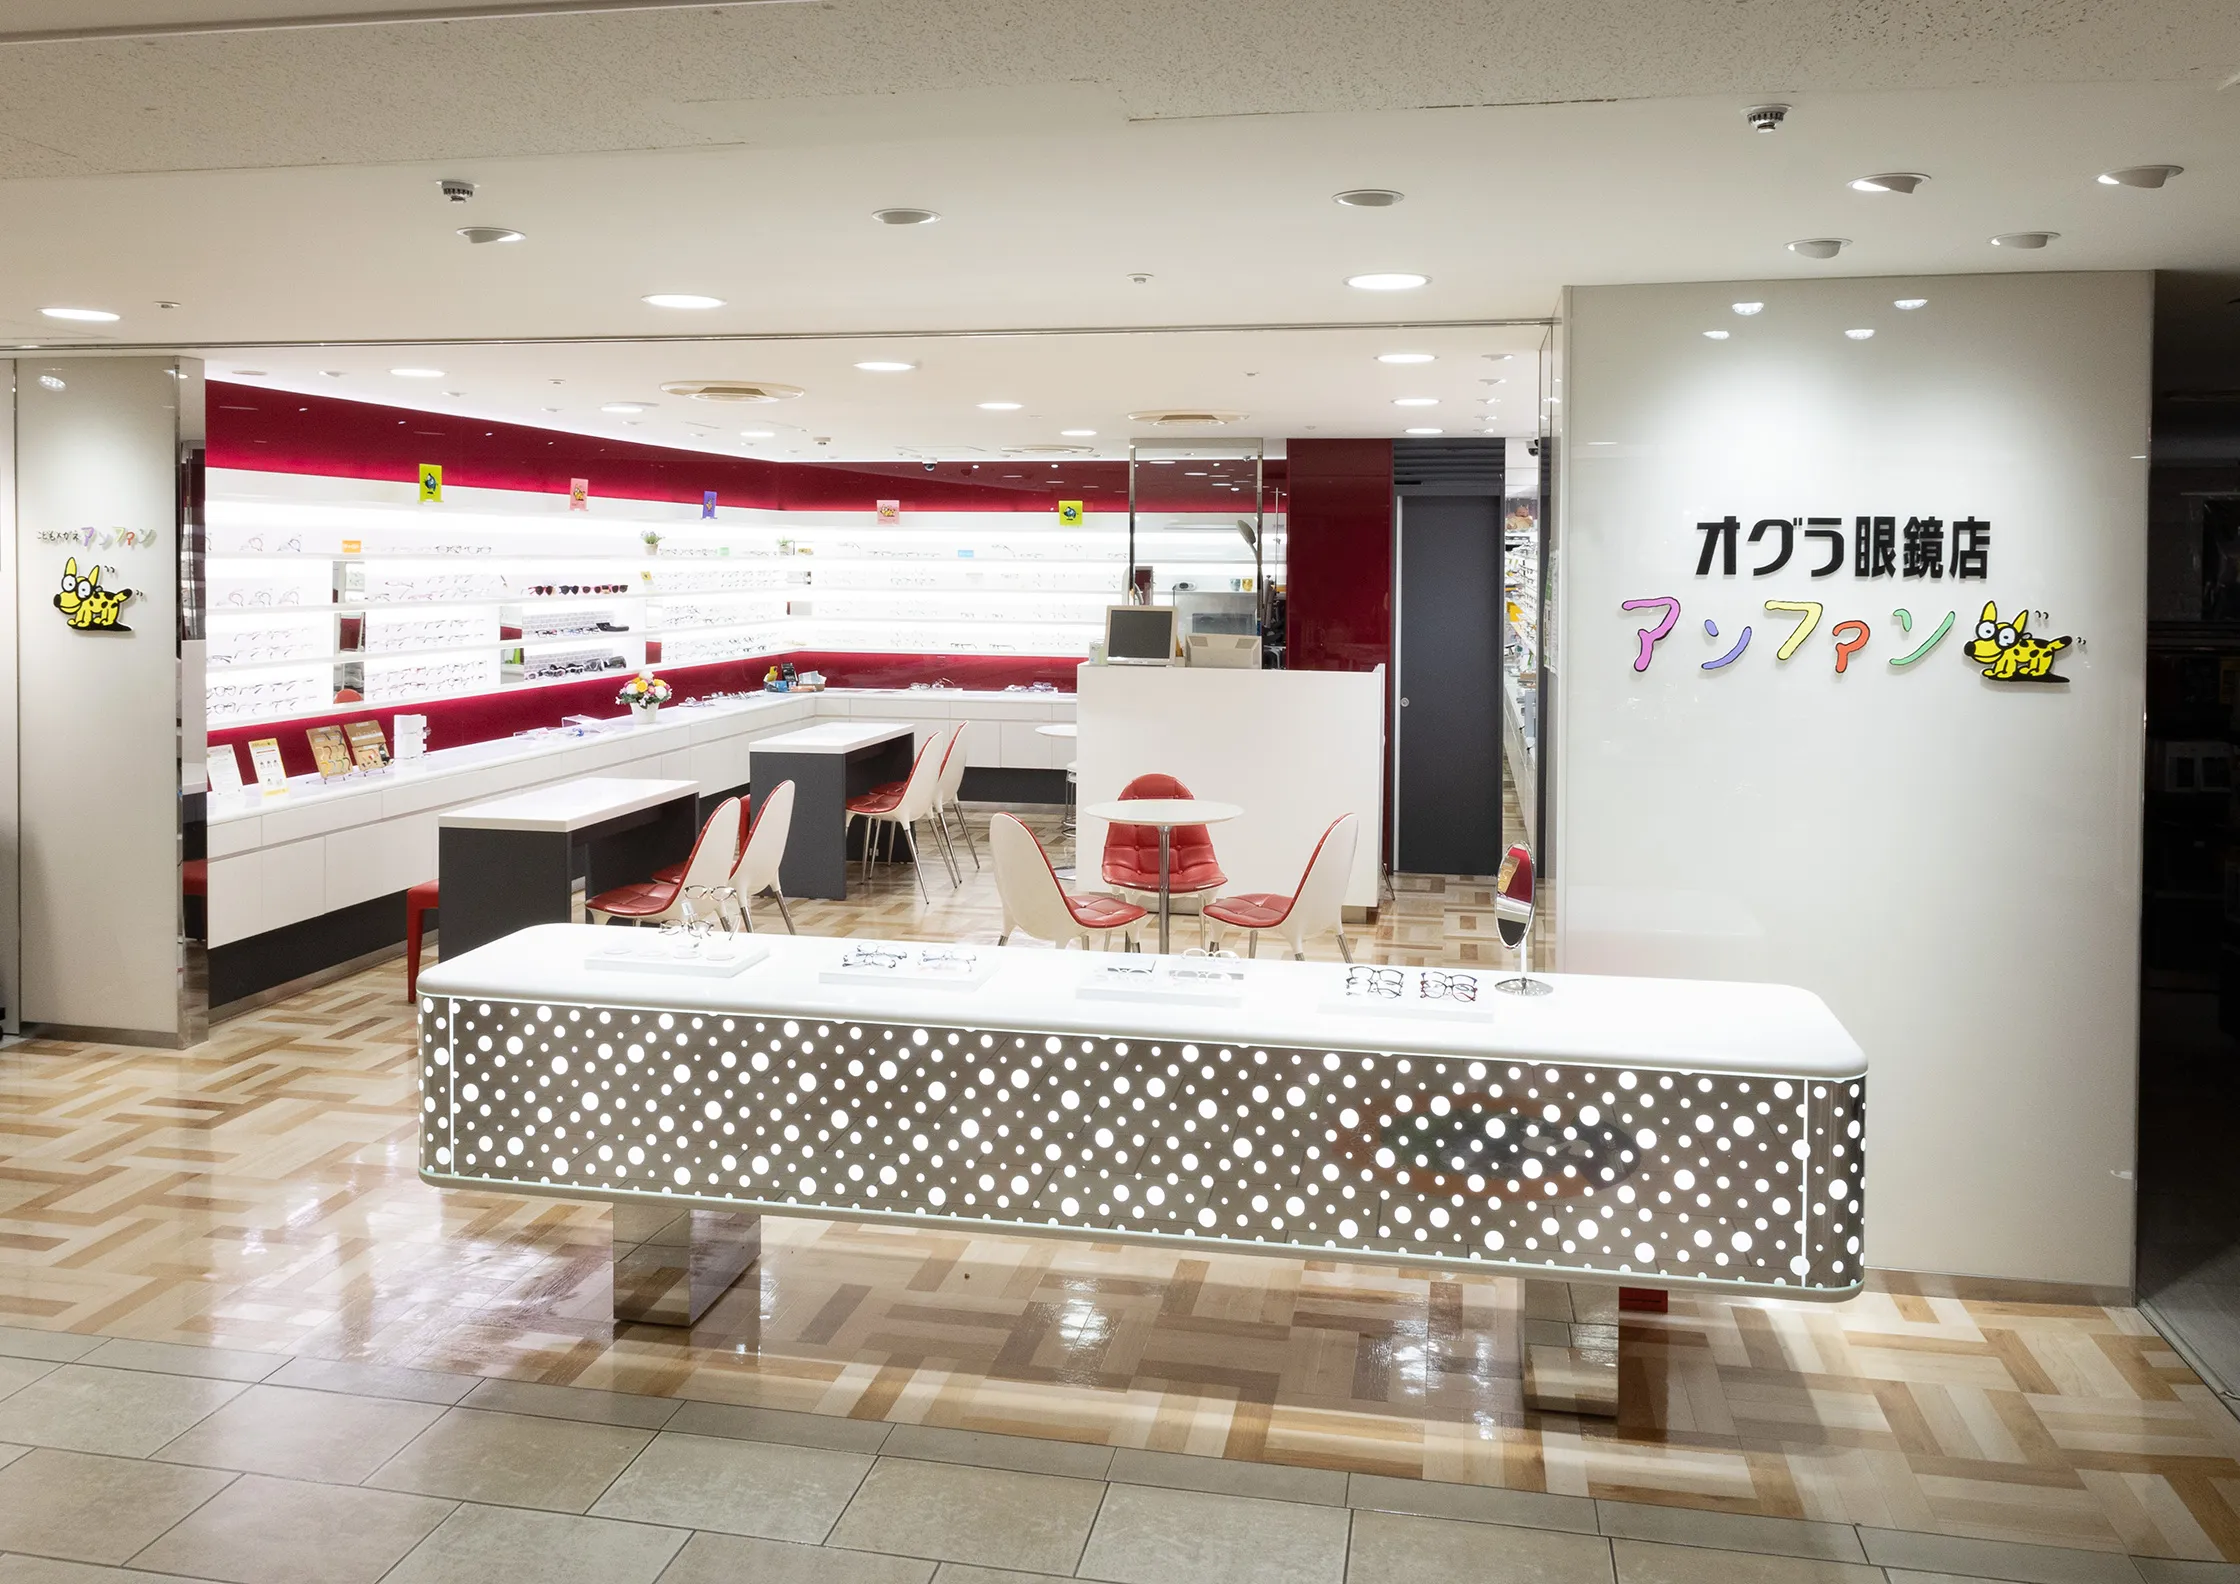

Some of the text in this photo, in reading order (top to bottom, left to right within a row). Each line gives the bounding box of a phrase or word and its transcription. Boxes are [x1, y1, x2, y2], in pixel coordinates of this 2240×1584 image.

[1695, 515, 1991, 579] オグラ眼鏡店
[1621, 596, 1956, 673] アンファン
